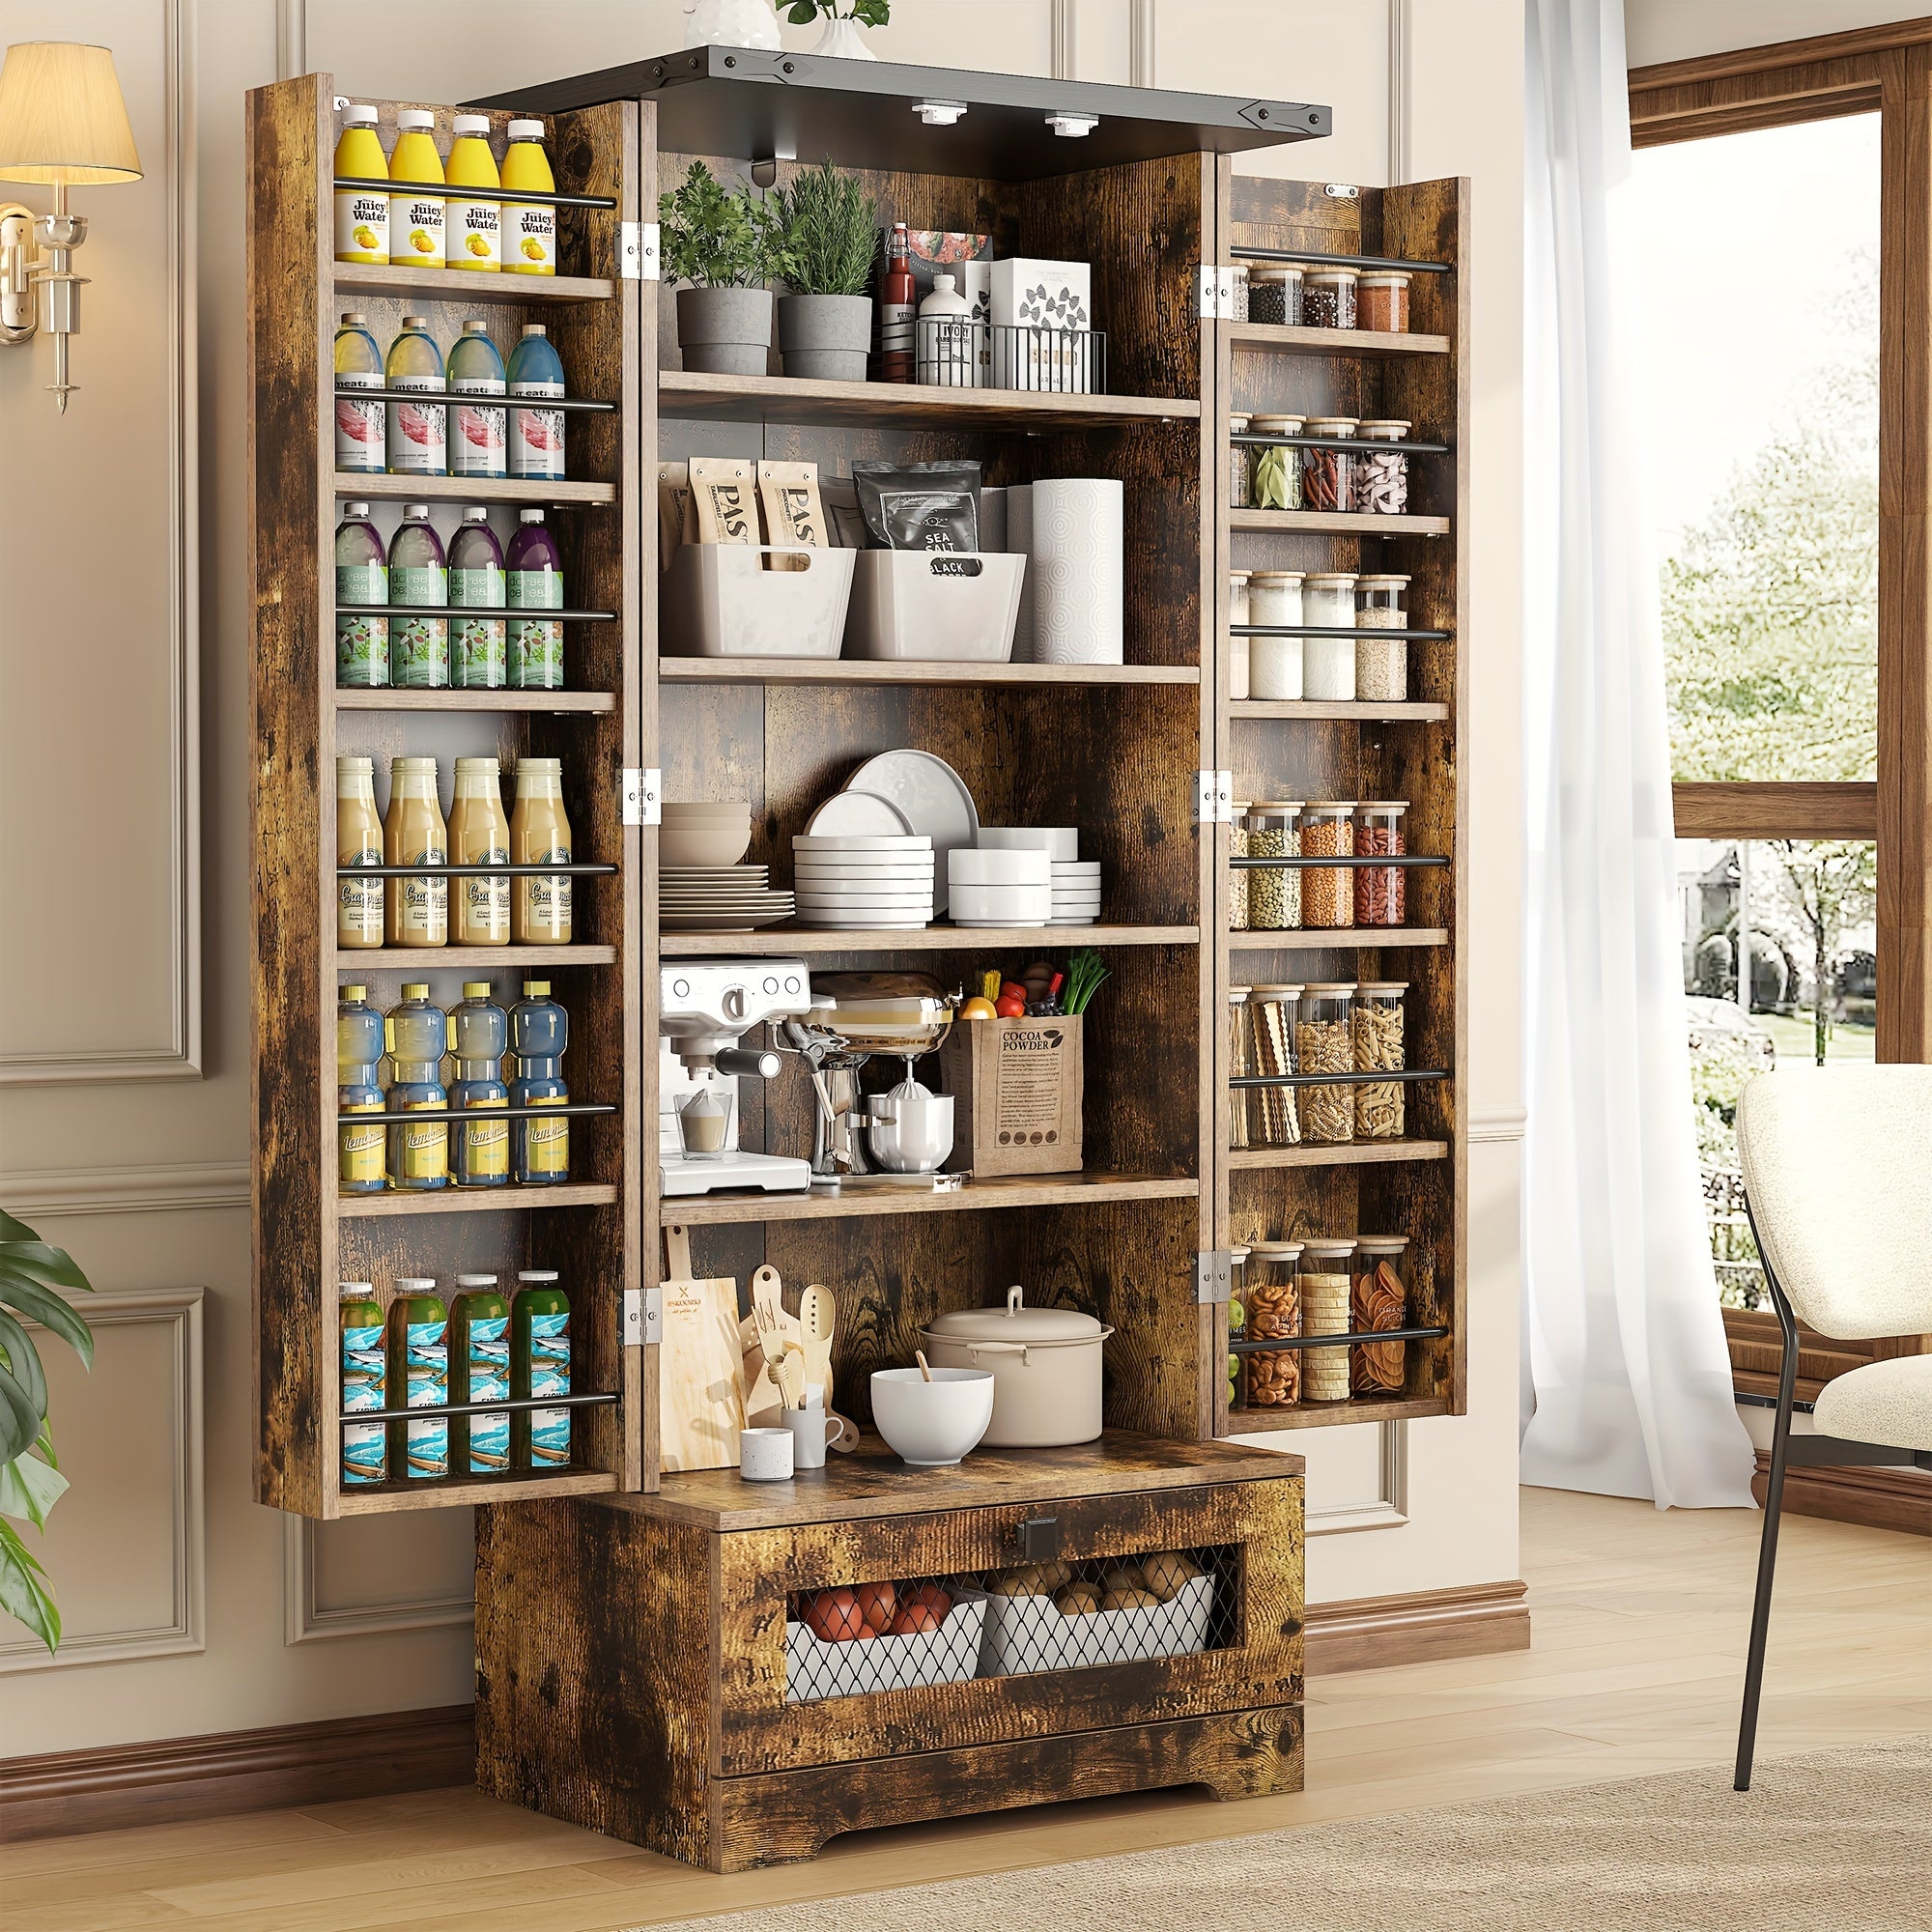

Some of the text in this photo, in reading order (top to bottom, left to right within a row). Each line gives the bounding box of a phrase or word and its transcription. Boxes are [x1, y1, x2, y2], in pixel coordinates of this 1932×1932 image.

[354, 199, 385, 213] Juicy
[411, 204, 442, 217] Juicy
[353, 210, 386, 222] Water
[410, 214, 443, 226] Water
[467, 208, 497, 222] Juicy
[522, 212, 553, 226] Juicy
[466, 218, 498, 230] Water
[521, 222, 554, 234] Water
[924, 532, 951, 544] SEA
[924, 542, 954, 552] SALT
[1003, 1031, 1041, 1041] COCOA
[1003, 1040, 1050, 1052] POWDER
